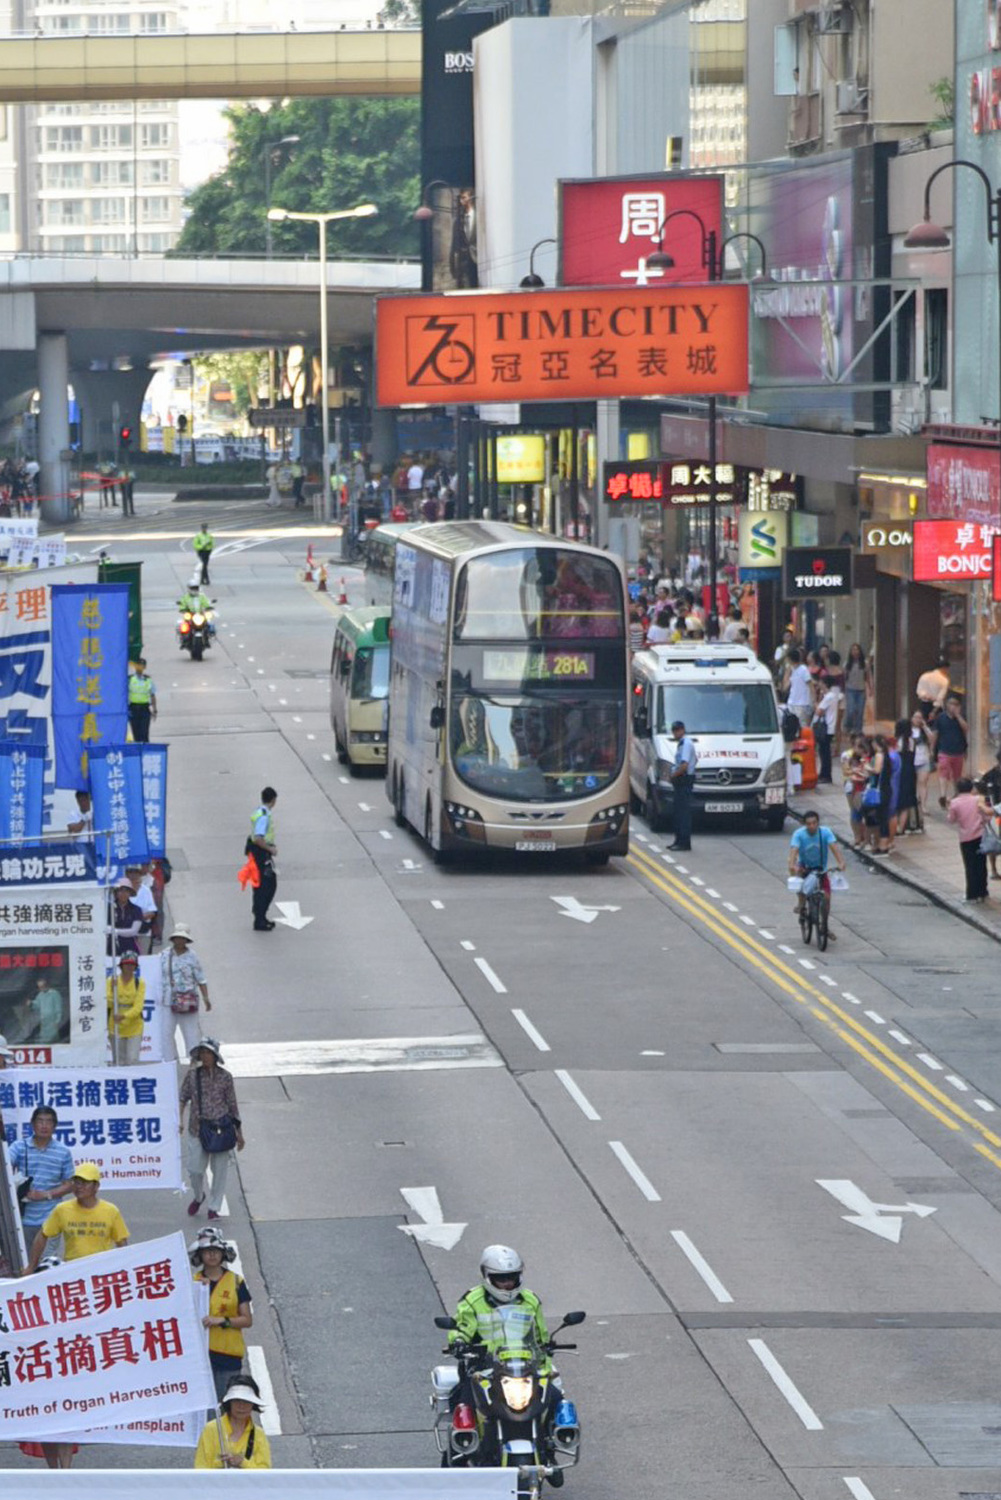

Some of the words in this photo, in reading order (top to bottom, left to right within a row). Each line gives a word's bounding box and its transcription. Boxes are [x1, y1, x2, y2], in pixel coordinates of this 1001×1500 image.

[488, 303, 718, 341] TIMECITY
[491, 346, 718, 383] 冠亞名表城
[795, 576, 843, 588] TUDOR
[553, 655, 589, 675] 281A
[18, 927, 60, 937] harvesting
[61, 927, 69, 935] in
[70, 926, 94, 935] China
[77, 955, 95, 1033] 活摘器官
[111, 1156, 122, 1164] in
[129, 1154, 162, 1164] China
[112, 1168, 162, 1179] Humanity
[3, 1405, 40, 1420] Truth
[44, 1401, 59, 1415] of
[62, 1393, 106, 1413] Organ
[109, 1380, 188, 1406] Harvesting
